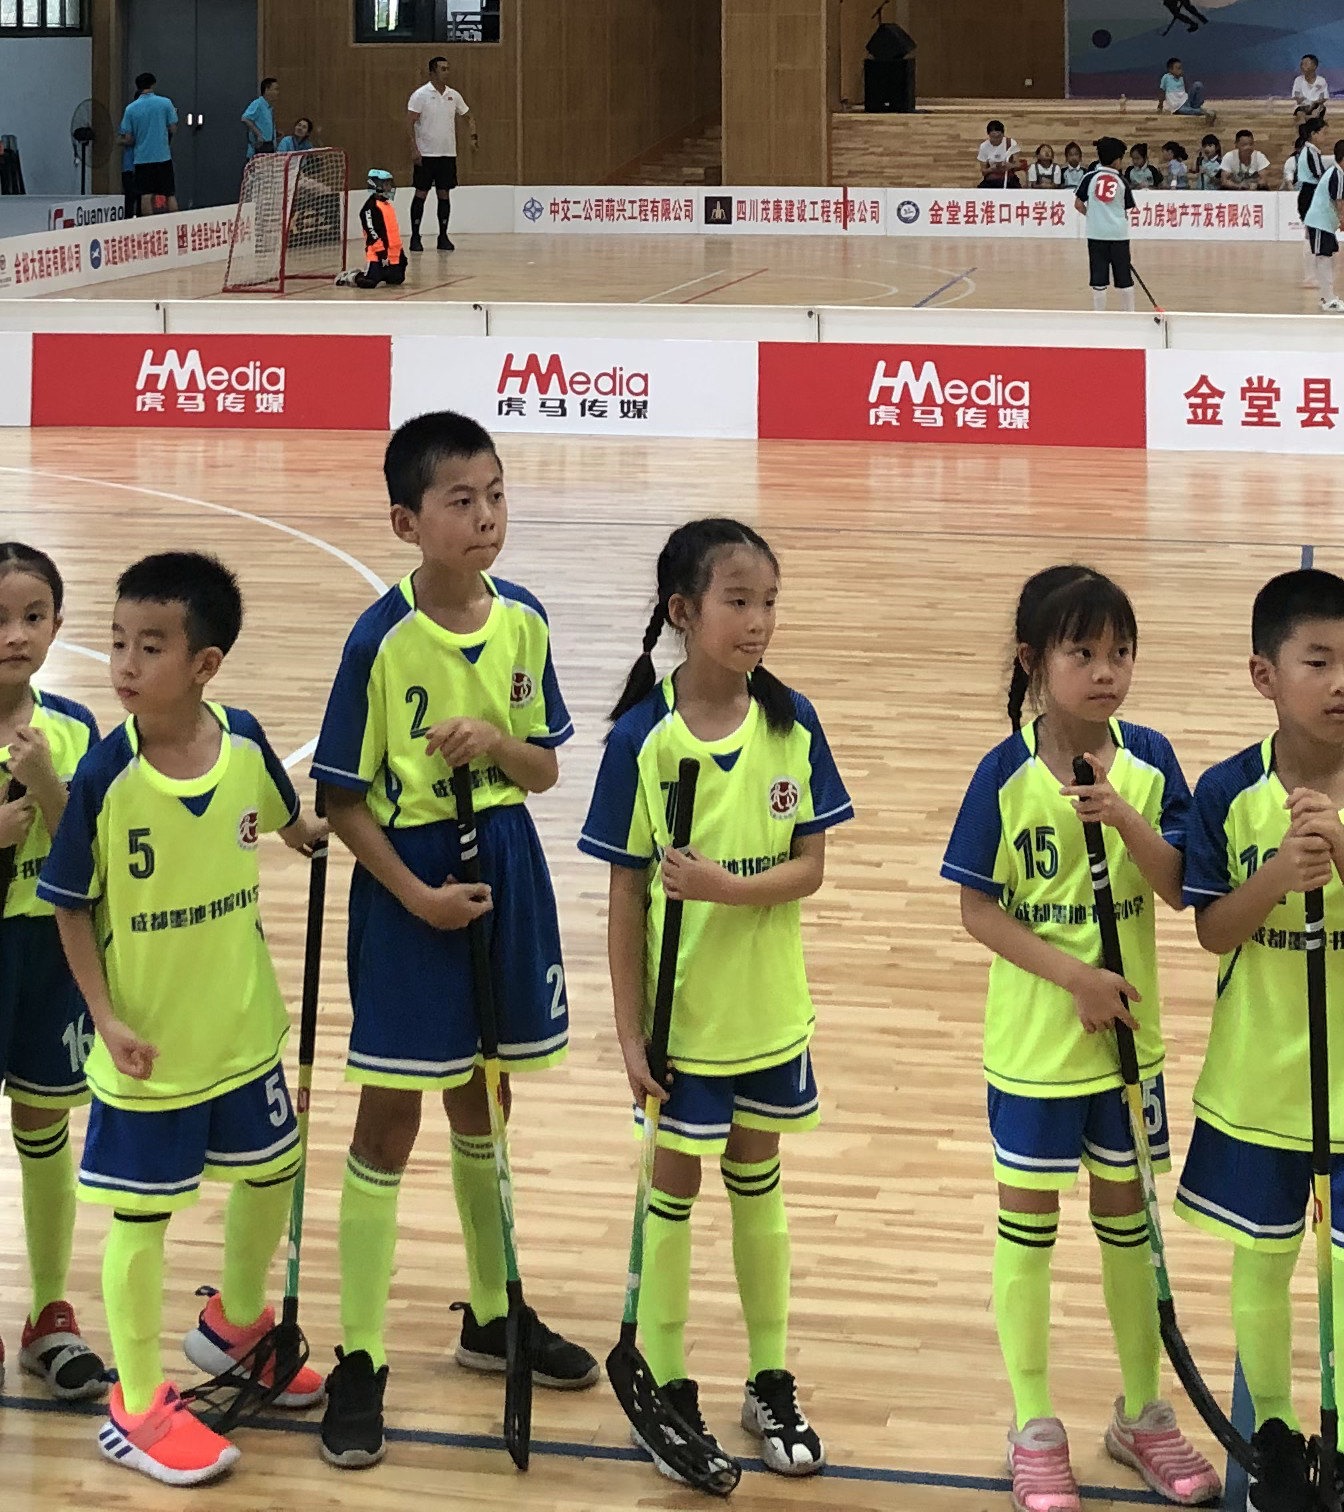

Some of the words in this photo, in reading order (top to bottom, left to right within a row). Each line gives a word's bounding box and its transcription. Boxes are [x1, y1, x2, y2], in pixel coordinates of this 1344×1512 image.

[1095, 178, 1118, 199] 13
[76, 205, 125, 227] Guanyao
[929, 200, 1066, 226] 金堂县淮口中学校
[136, 349, 286, 392] HMedia
[497, 353, 649, 396] HMedia
[868, 360, 1030, 406] HMedia
[136, 392, 285, 414] 虎马传媒
[498, 396, 649, 420] 虎马传媒
[868, 405, 1030, 429] 虎马传媒
[404, 685, 429, 740] 2
[128, 828, 155, 879] 5
[1014, 826, 1060, 880] 15
[546, 963, 567, 1019] 2
[62, 1012, 95, 1073] 16
[265, 1072, 288, 1128] 5
